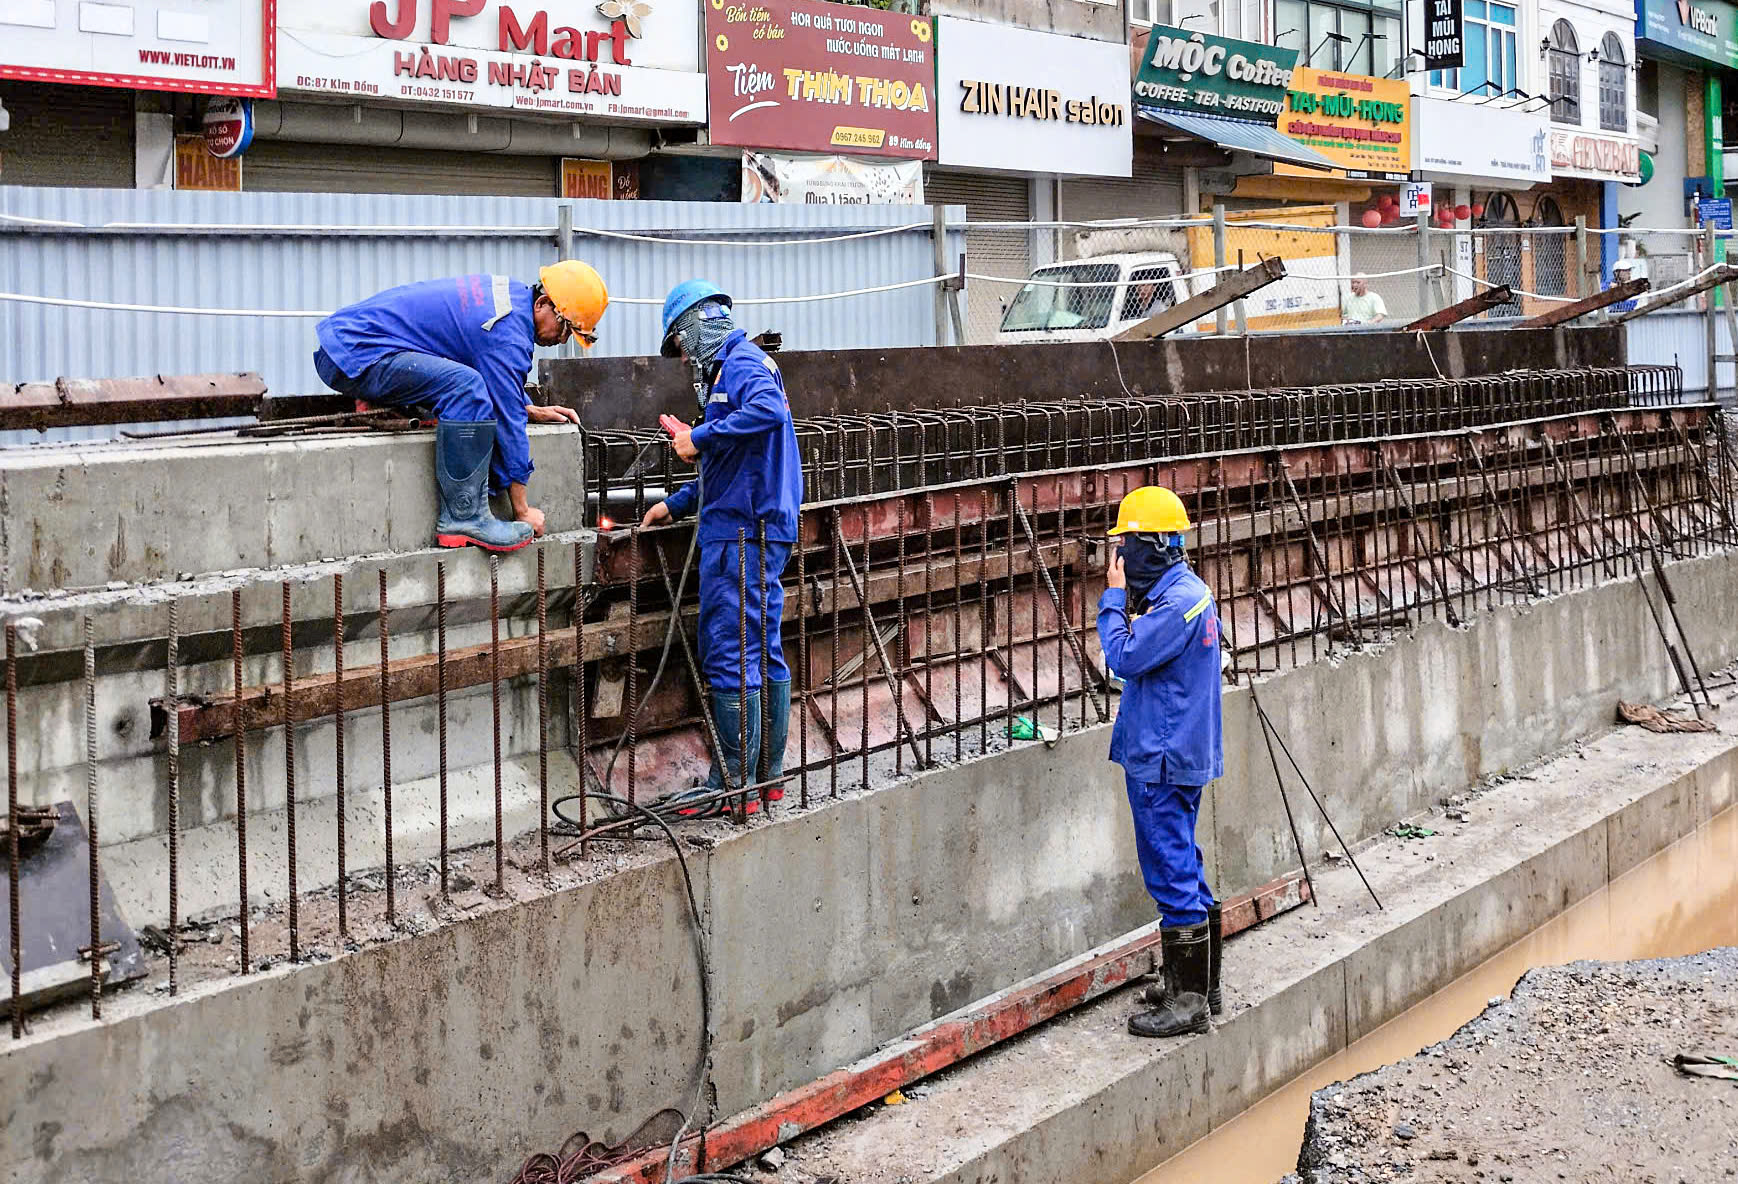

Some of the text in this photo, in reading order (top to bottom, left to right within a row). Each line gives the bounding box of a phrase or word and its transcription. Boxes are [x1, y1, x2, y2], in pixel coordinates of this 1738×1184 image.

[725, 2, 771, 26] Bổn tiệm
[1434, 0, 1452, 17] TAI
[369, 0, 632, 66] JP Mart
[752, 23, 785, 39] có bán
[790, 11, 883, 37] HOA QUẢ TƯƠI NGON
[1432, 17, 1455, 37] MŨI
[138, 49, 236, 71] WWW.VIETLOTT.VN
[826, 35, 925, 65] NƯỚC UỐNG MÁT LẠNH
[1428, 37, 1460, 59] HỌNG
[393, 46, 622, 96] HÀNG NHẬT BẢN
[1151, 33, 1227, 82] MỘC
[1226, 54, 1292, 89] Coffee
[725, 62, 929, 112] Tiệm THÍM THOA
[959, 79, 1125, 128] ZIN HAIR salon
[805, 191, 828, 204] Mua
